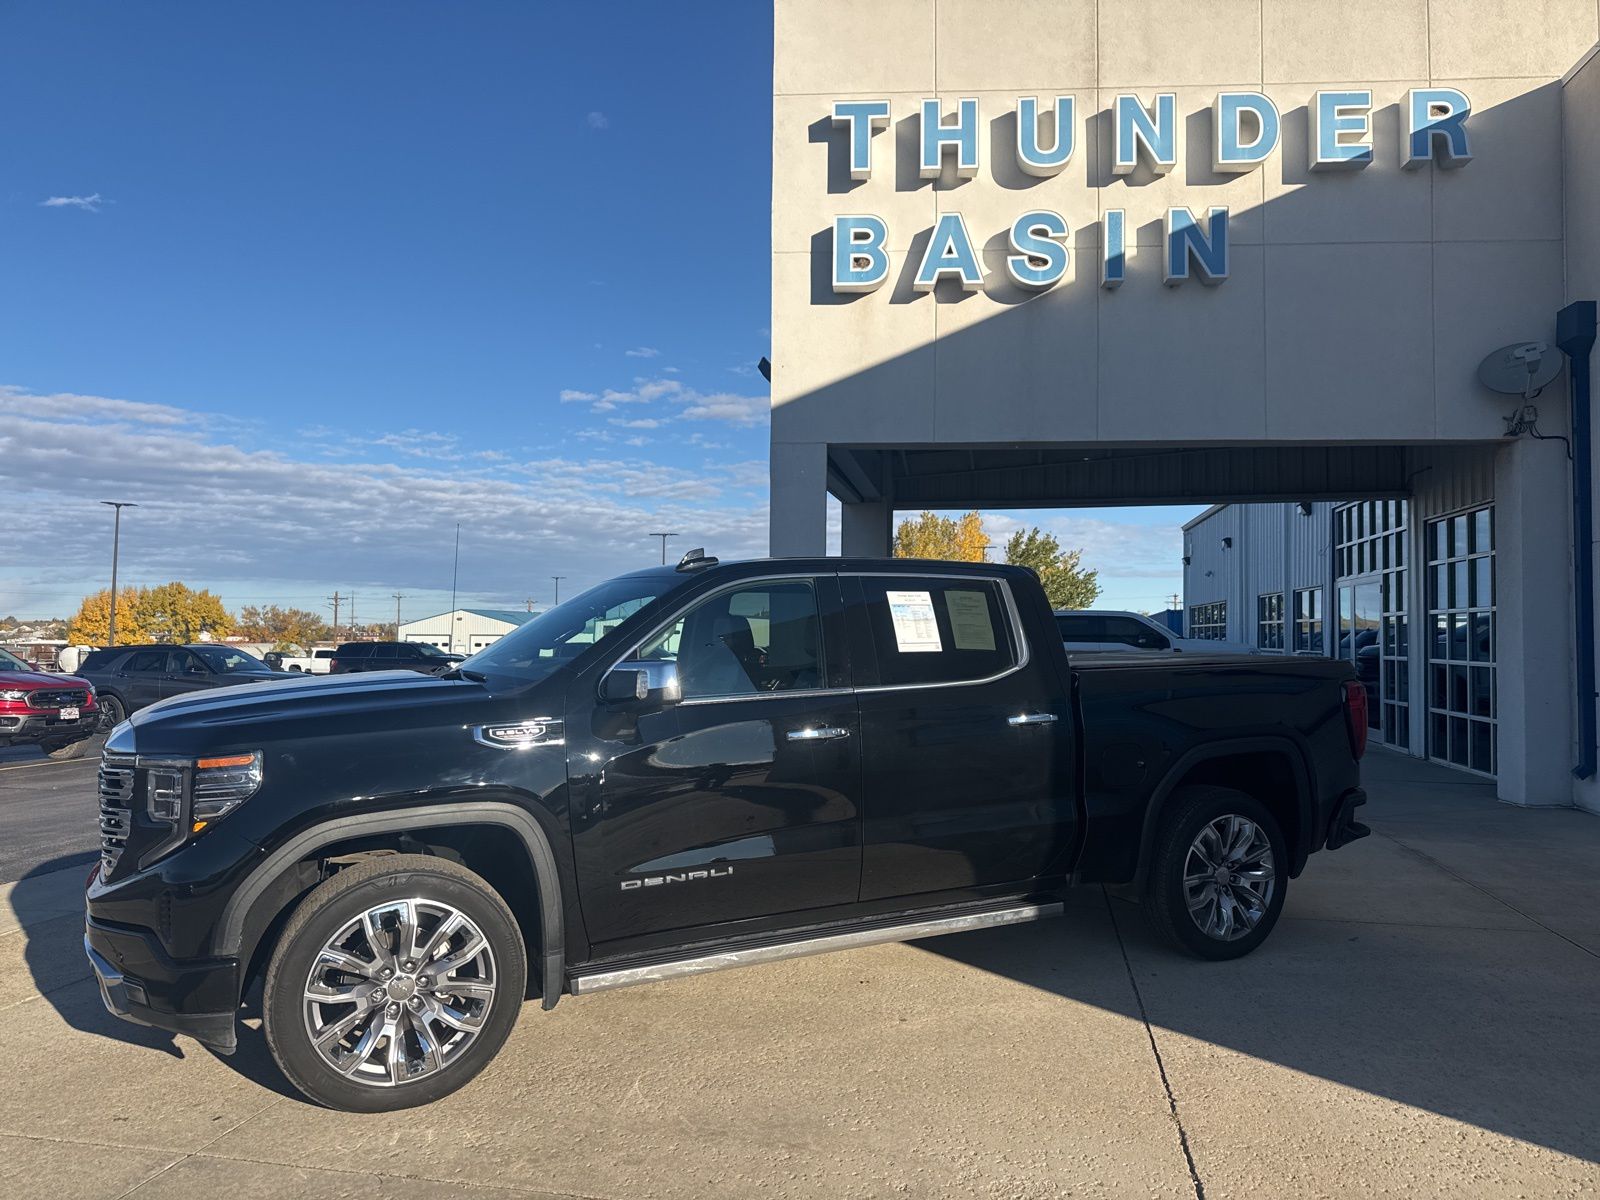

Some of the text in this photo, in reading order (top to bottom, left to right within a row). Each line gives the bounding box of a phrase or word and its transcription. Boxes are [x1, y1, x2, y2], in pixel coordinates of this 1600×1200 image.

[832, 87, 1474, 179] THUNDER
[832, 206, 1230, 293] BASIN
[621, 866, 734, 890] DENALI
